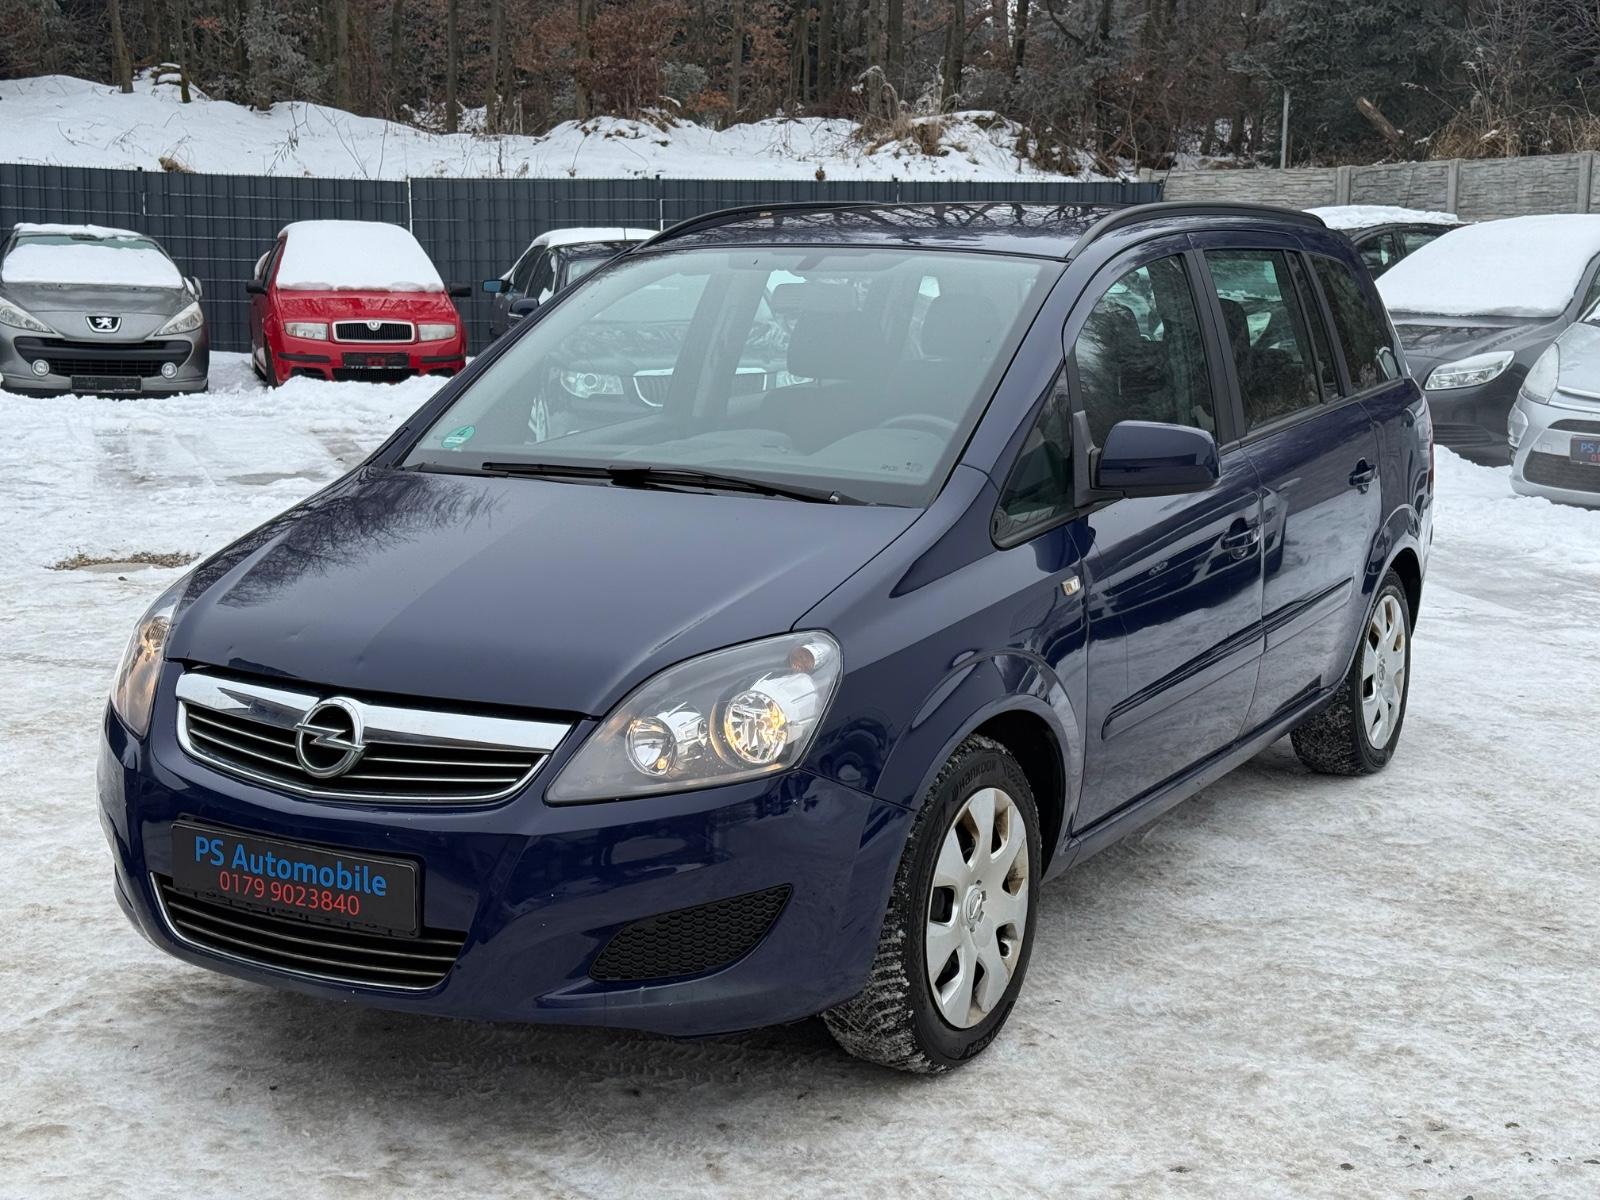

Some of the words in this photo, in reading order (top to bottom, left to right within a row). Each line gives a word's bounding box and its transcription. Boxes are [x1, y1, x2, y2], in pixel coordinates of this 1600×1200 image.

[1581, 442, 1594, 454] PS
[194, 835, 225, 867] PS
[231, 843, 387, 897] Automobile
[219, 871, 265, 899] 0179
[270, 881, 360, 916] 9023840
